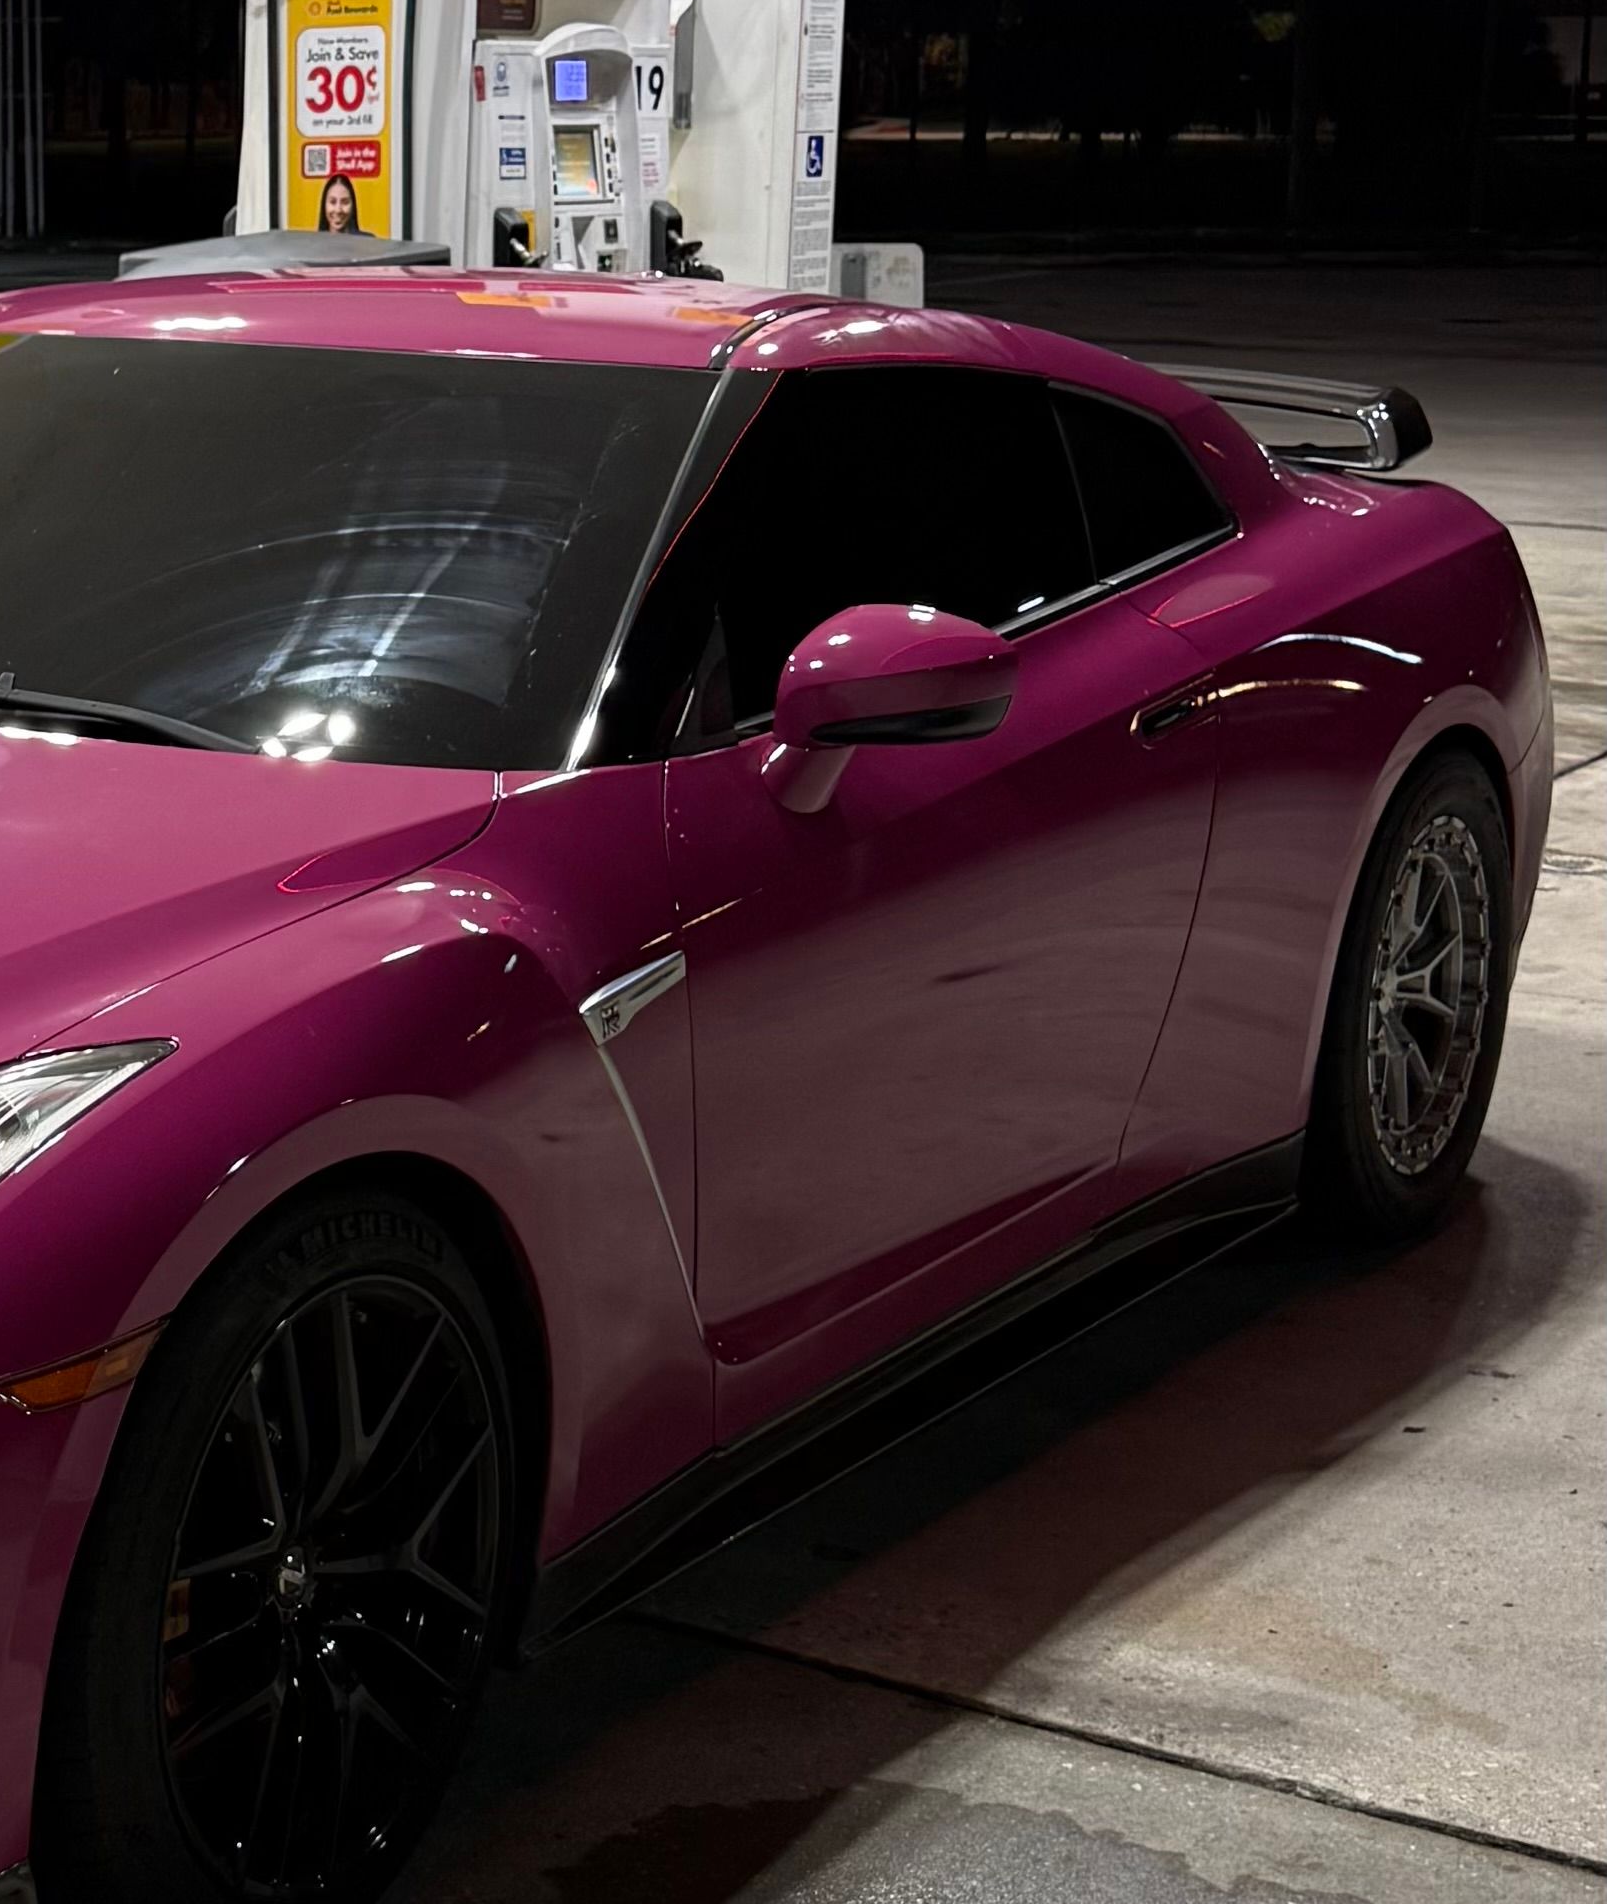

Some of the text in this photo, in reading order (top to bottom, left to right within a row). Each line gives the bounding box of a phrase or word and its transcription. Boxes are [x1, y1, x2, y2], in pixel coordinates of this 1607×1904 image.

[306, 46, 380, 64] Join & Save
[635, 64, 665, 112] 19
